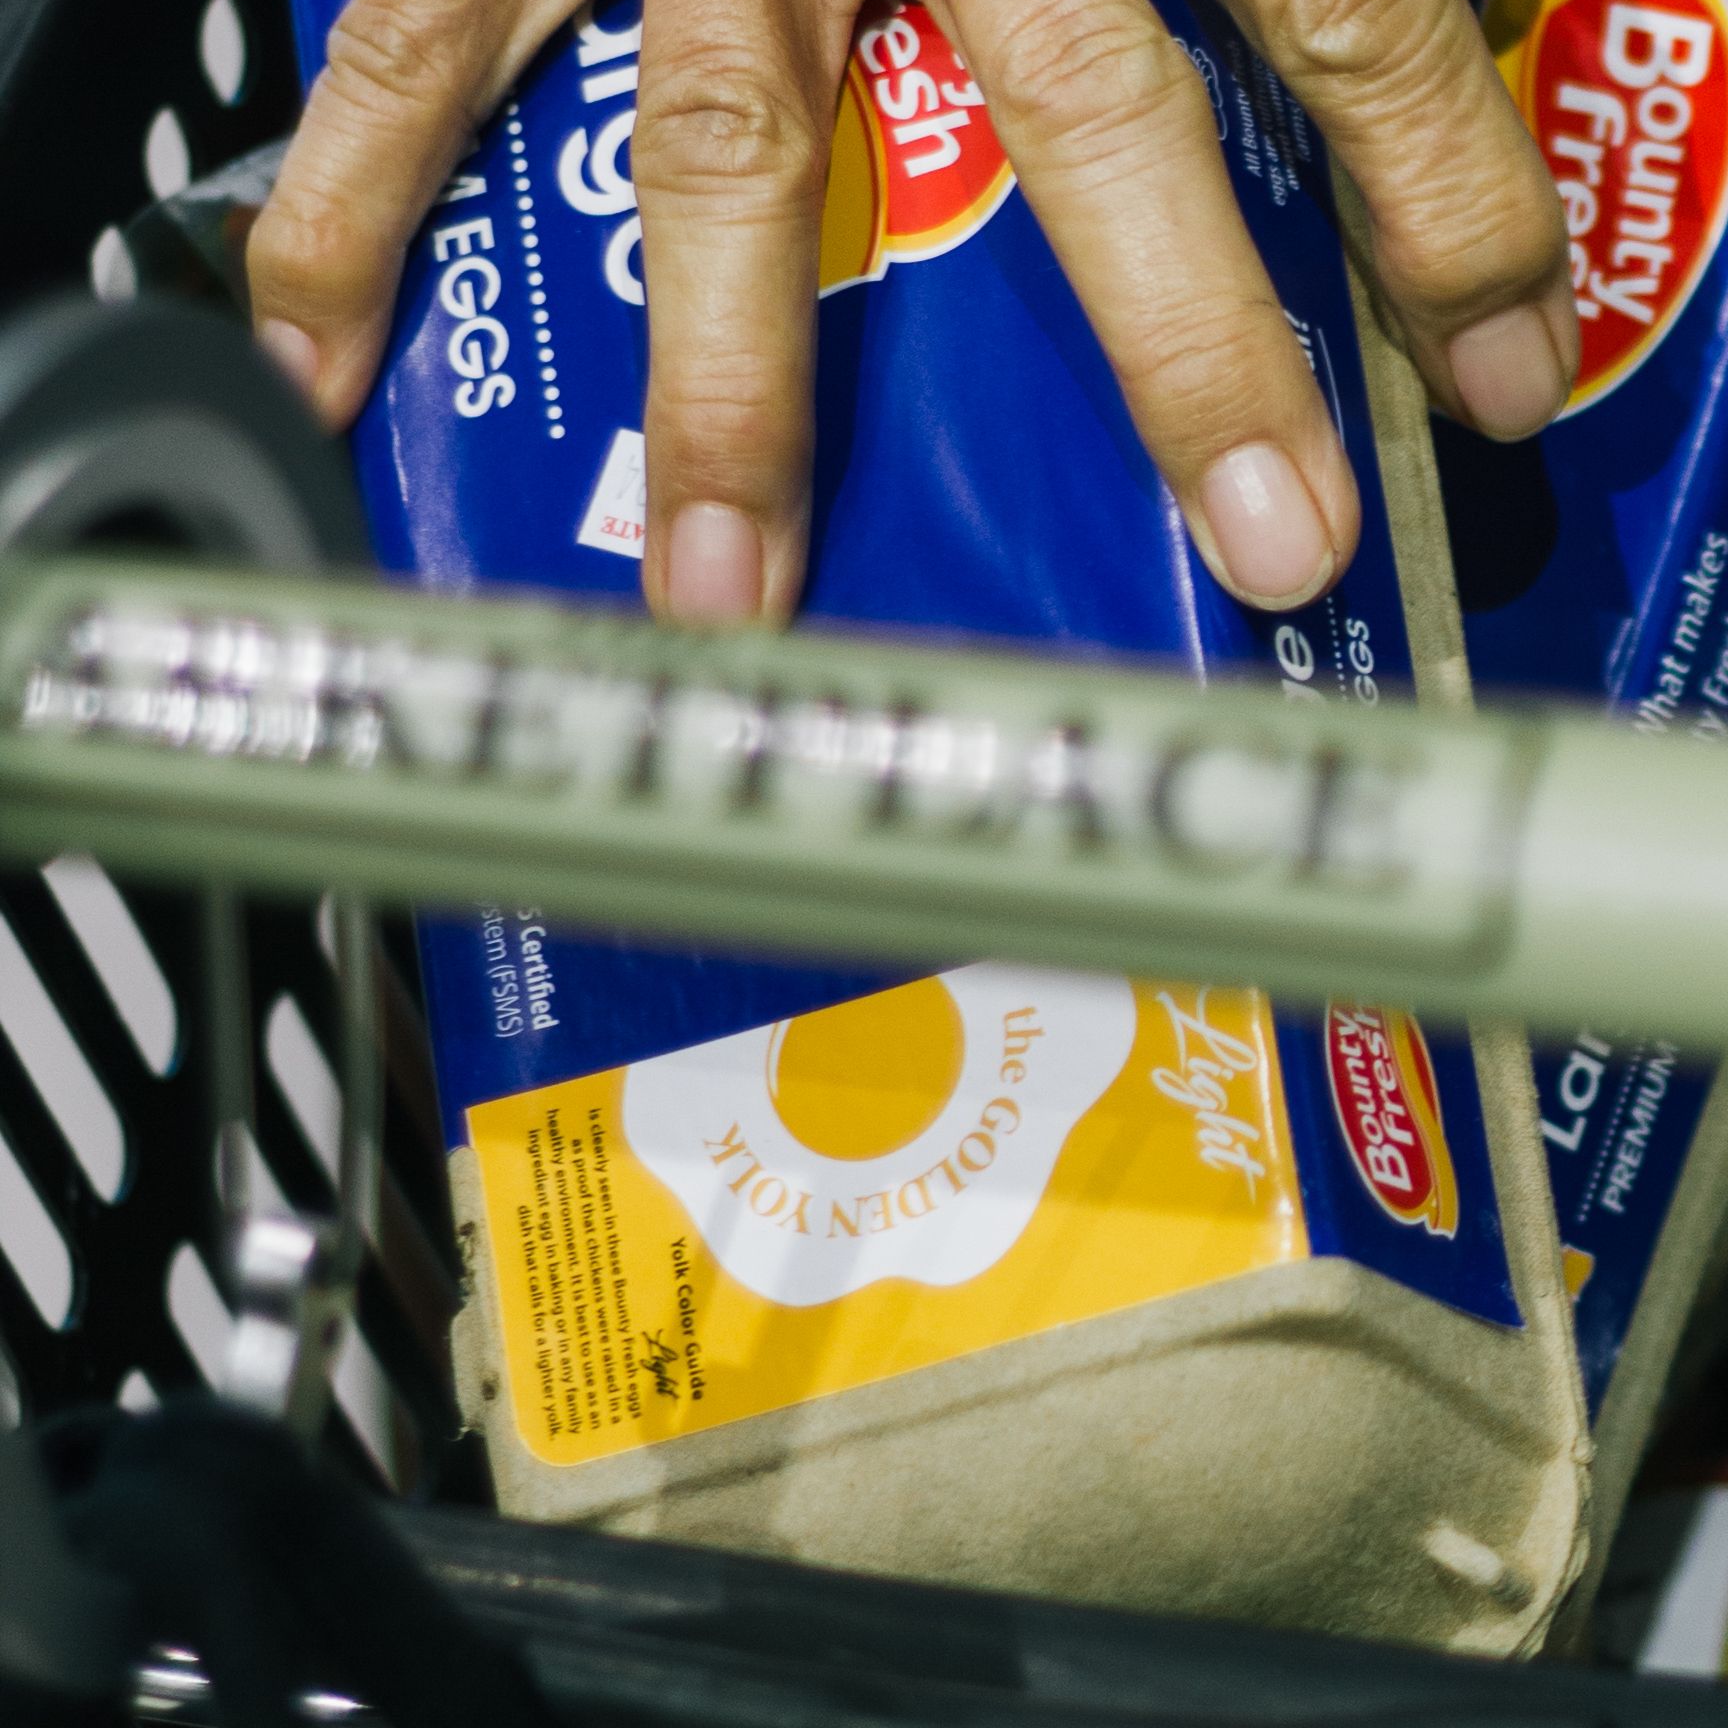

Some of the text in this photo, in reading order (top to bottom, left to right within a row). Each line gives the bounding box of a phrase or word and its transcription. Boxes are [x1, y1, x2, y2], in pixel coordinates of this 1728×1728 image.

[1236, 87, 1257, 149] Bounty
[1245, 149, 1262, 178] All
[1603, 0, 1713, 325] Bounty
[433, 216, 517, 420] EGGS
[484, 963, 525, 1039] (FSMS)
[517, 924, 560, 1031] Certified
[707, 1006, 1044, 1239] the GOLDEN YOLK
[1151, 988, 1266, 1202] Light
[1335, 1007, 1412, 1193] Bounty
[1605, 1040, 1677, 1214] PREMIUM
